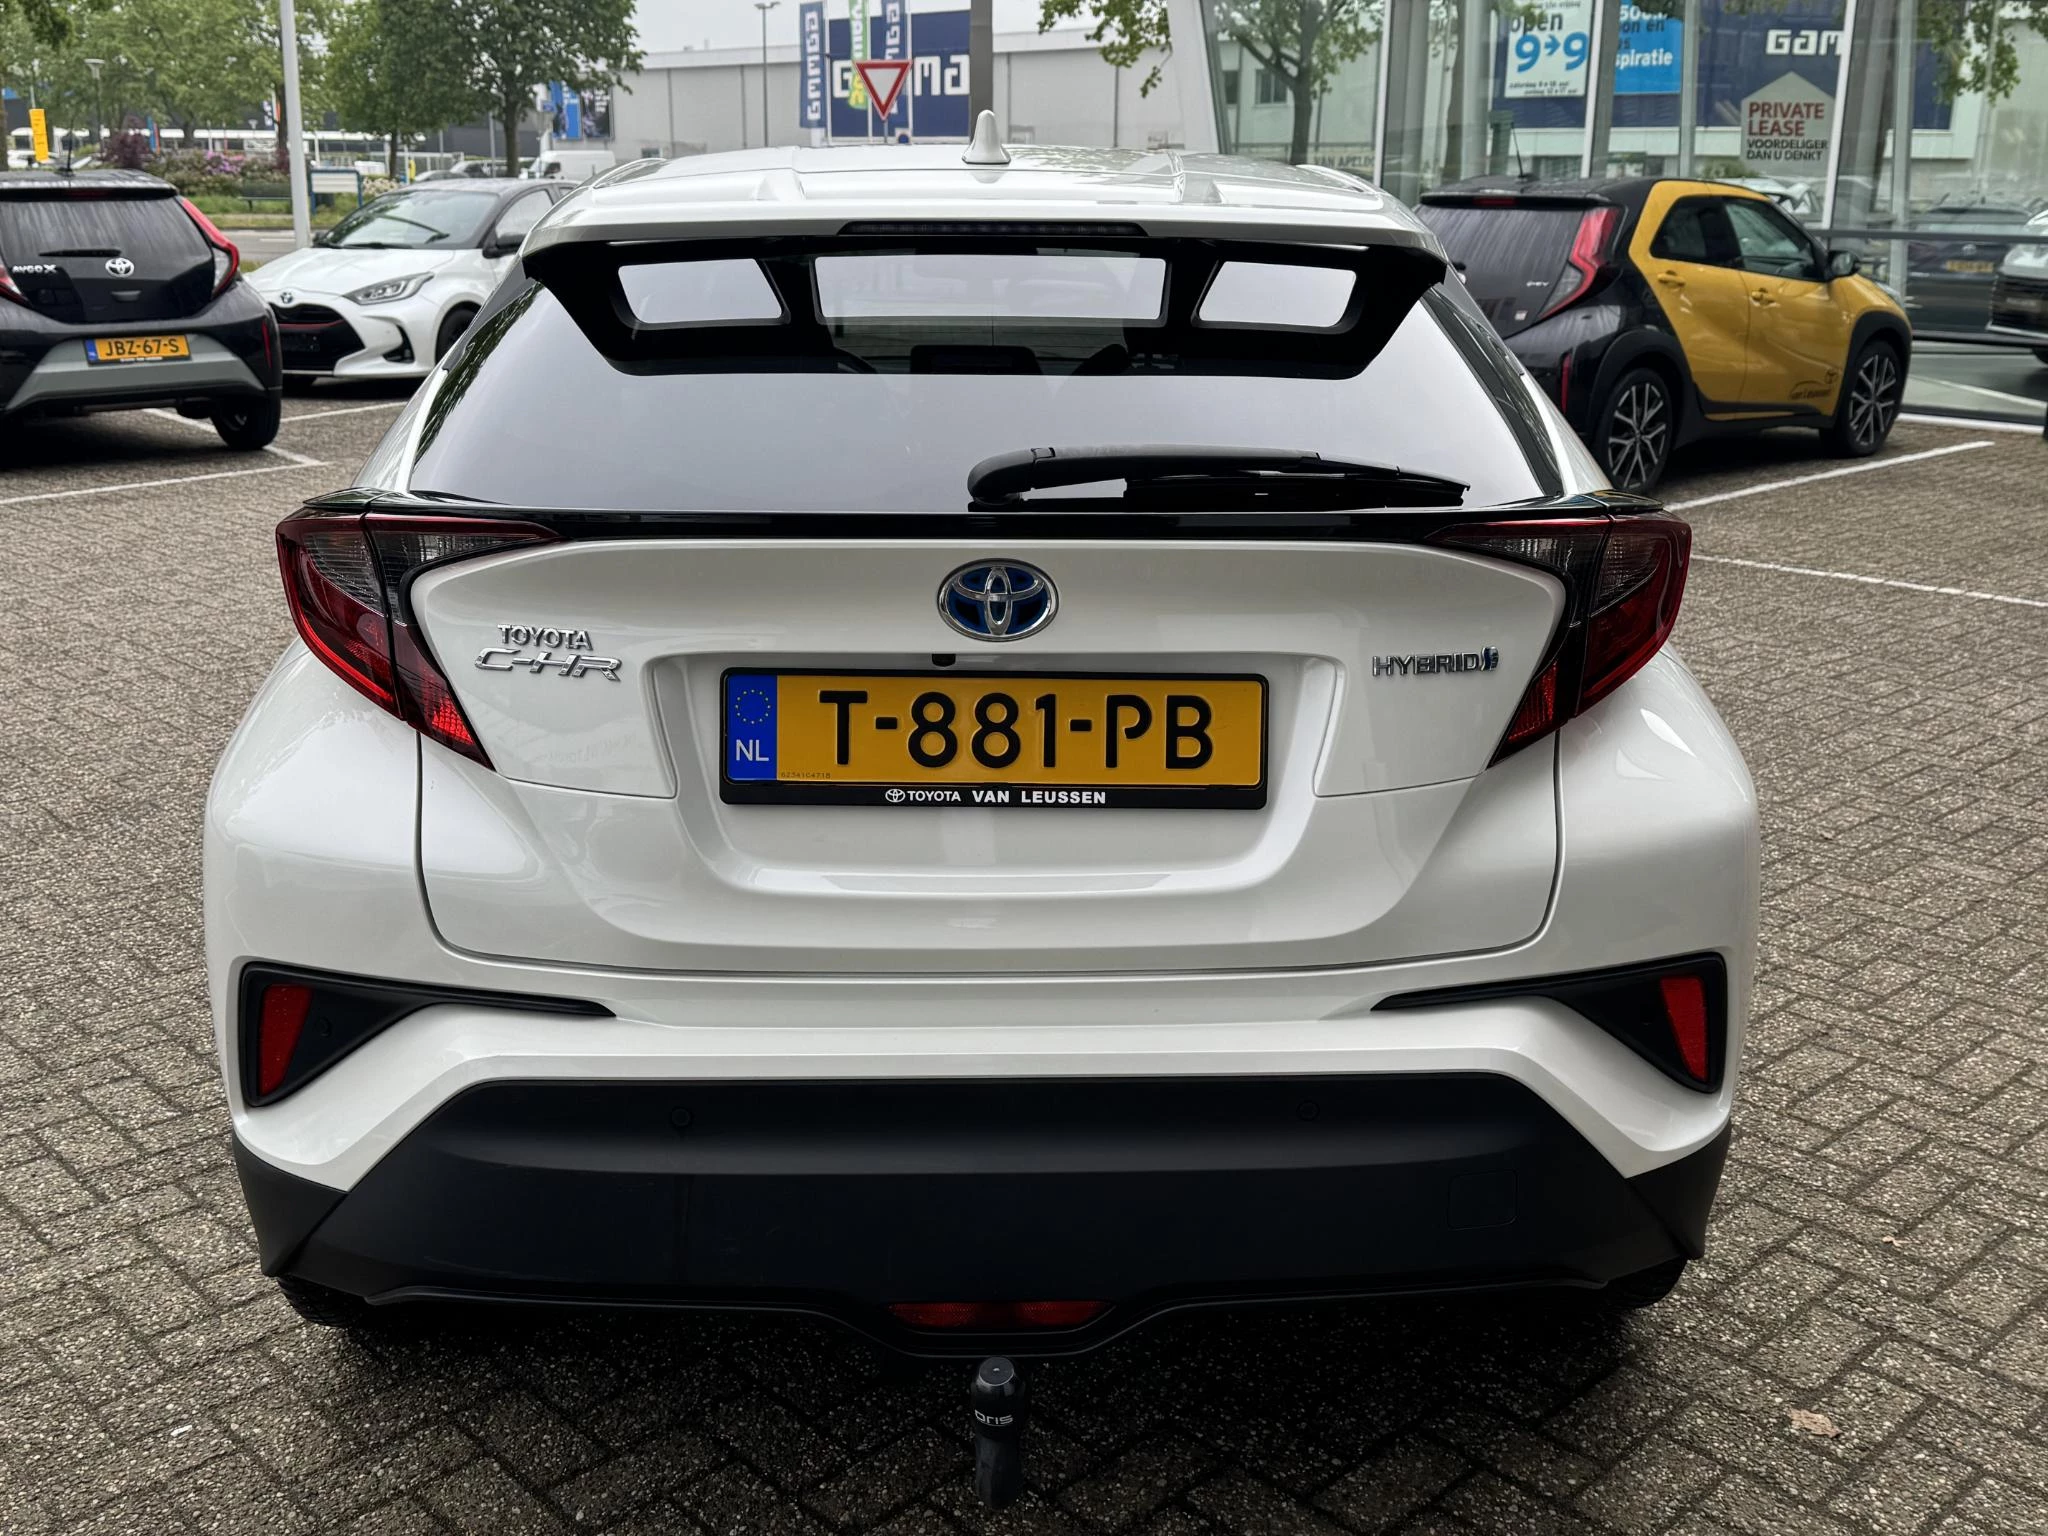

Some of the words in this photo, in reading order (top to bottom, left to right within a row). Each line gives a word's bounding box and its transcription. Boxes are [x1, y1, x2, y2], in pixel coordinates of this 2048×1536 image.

[1748, 102, 1825, 119] PRIVATE
[1747, 120, 1805, 136] LEASE
[1747, 150, 1772, 160] DAN
[1774, 150, 1783, 160] U
[1785, 149, 1823, 160] DENKT
[106, 338, 179, 356] JBZ-67-S
[497, 624, 593, 650] TOYOTA
[475, 647, 622, 682] C-HR
[1372, 652, 1480, 676] HYBRID
[819, 690, 1213, 769] T-881-PB
[735, 739, 769, 762] NL
[907, 790, 961, 802] TOYOTA
[972, 790, 1010, 803] VAN
[1021, 791, 1106, 804] LEUSSEN
